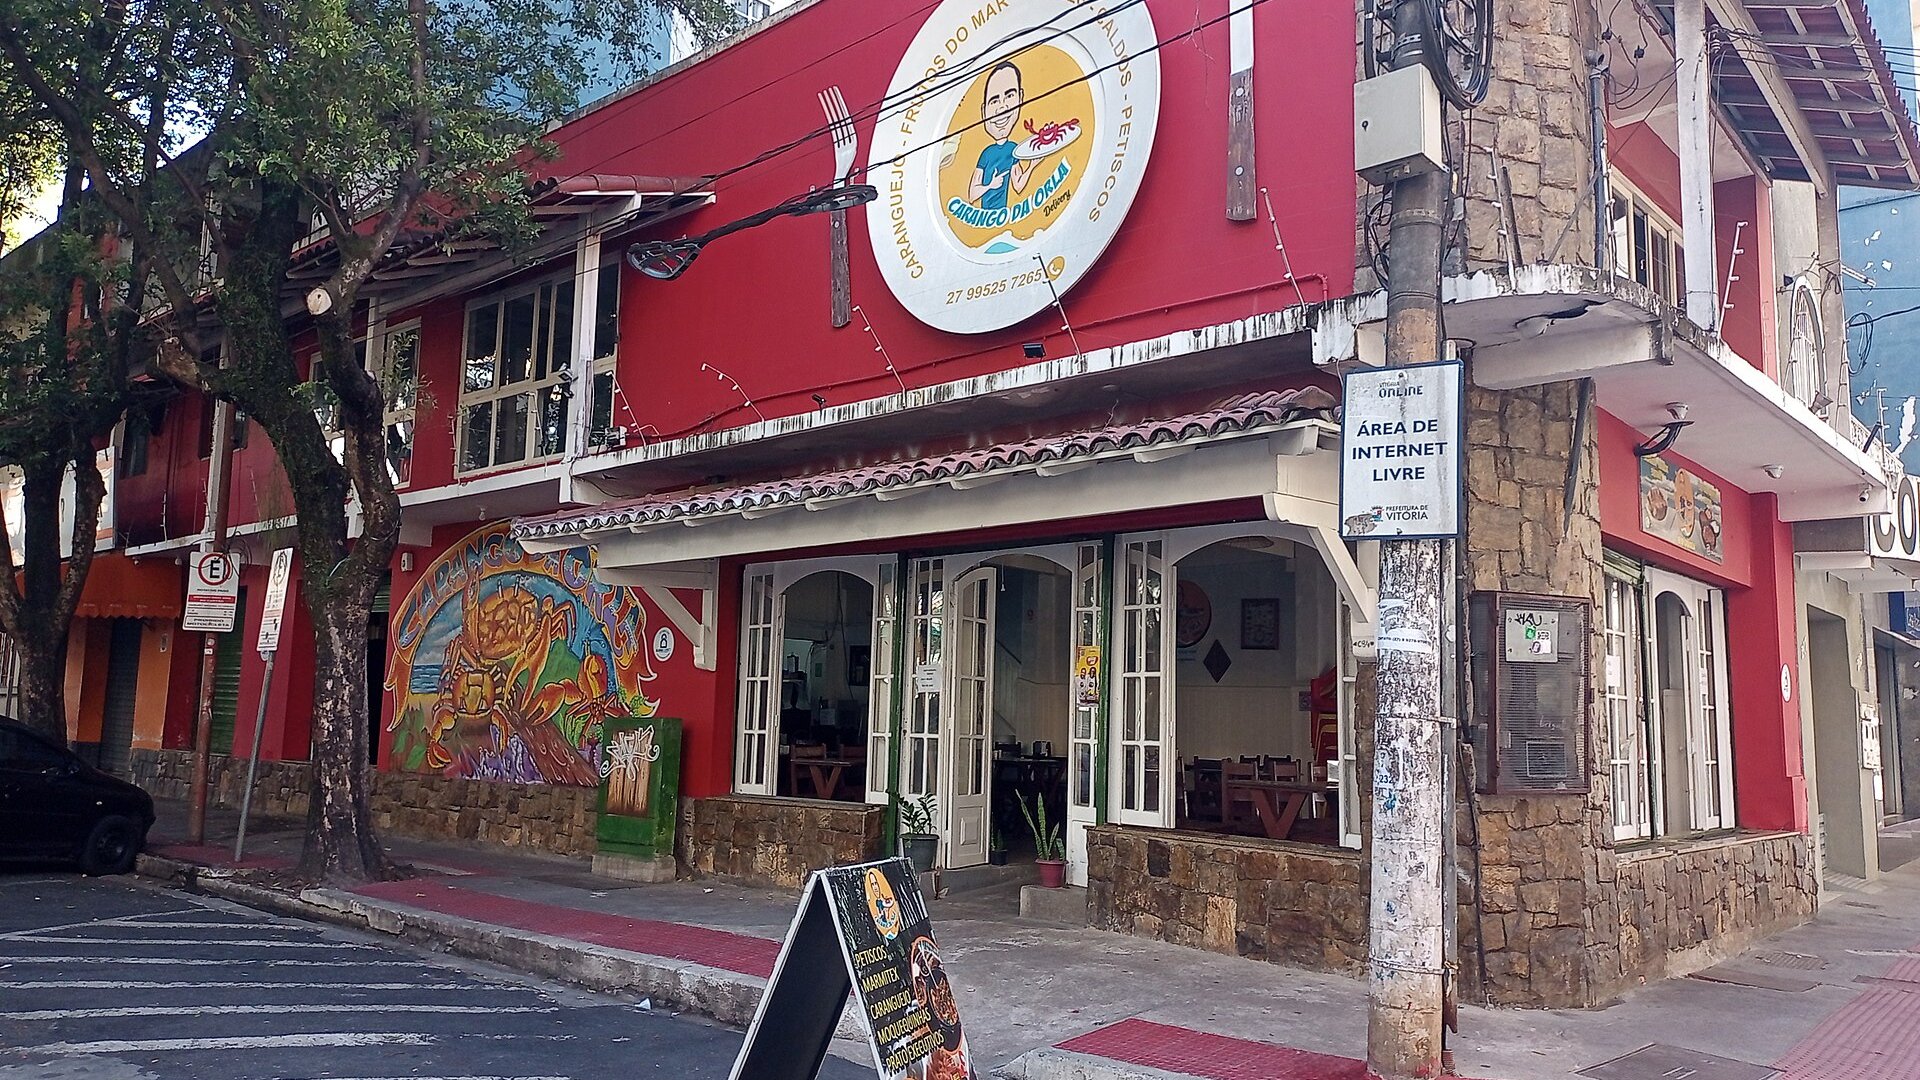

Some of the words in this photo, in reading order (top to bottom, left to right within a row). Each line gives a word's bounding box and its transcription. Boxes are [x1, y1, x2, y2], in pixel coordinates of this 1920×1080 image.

[1096, 7, 1132, 87] CALDOS
[890, 154, 924, 279] CARANGUEJO
[945, 26, 969, 55] DO
[970, 0, 1009, 30] MAR
[1088, 105, 1133, 222] PETISCOS
[948, 197, 1009, 228] CARANGO
[1011, 200, 1031, 222] DA
[1033, 161, 1070, 208] ORLA
[1043, 188, 1072, 217] Delivery
[945, 289, 964, 305] 27
[966, 278, 1007, 301] 99525
[1010, 268, 1043, 290] 7265
[1356, 420, 1407, 437] ÁREA
[1412, 419, 1438, 434] DE
[1352, 442, 1448, 460] INTERNET
[1373, 467, 1425, 482] LIVRE
[209, 559, 221, 579] E
[855, 945, 887, 968] PETISCOS
[861, 966, 900, 993] MARMITEX
[870, 988, 912, 1020] CARANGUEJO
[885, 1049, 909, 1073] PRATO
[907, 1030, 945, 1063] EXECUTIVOS
